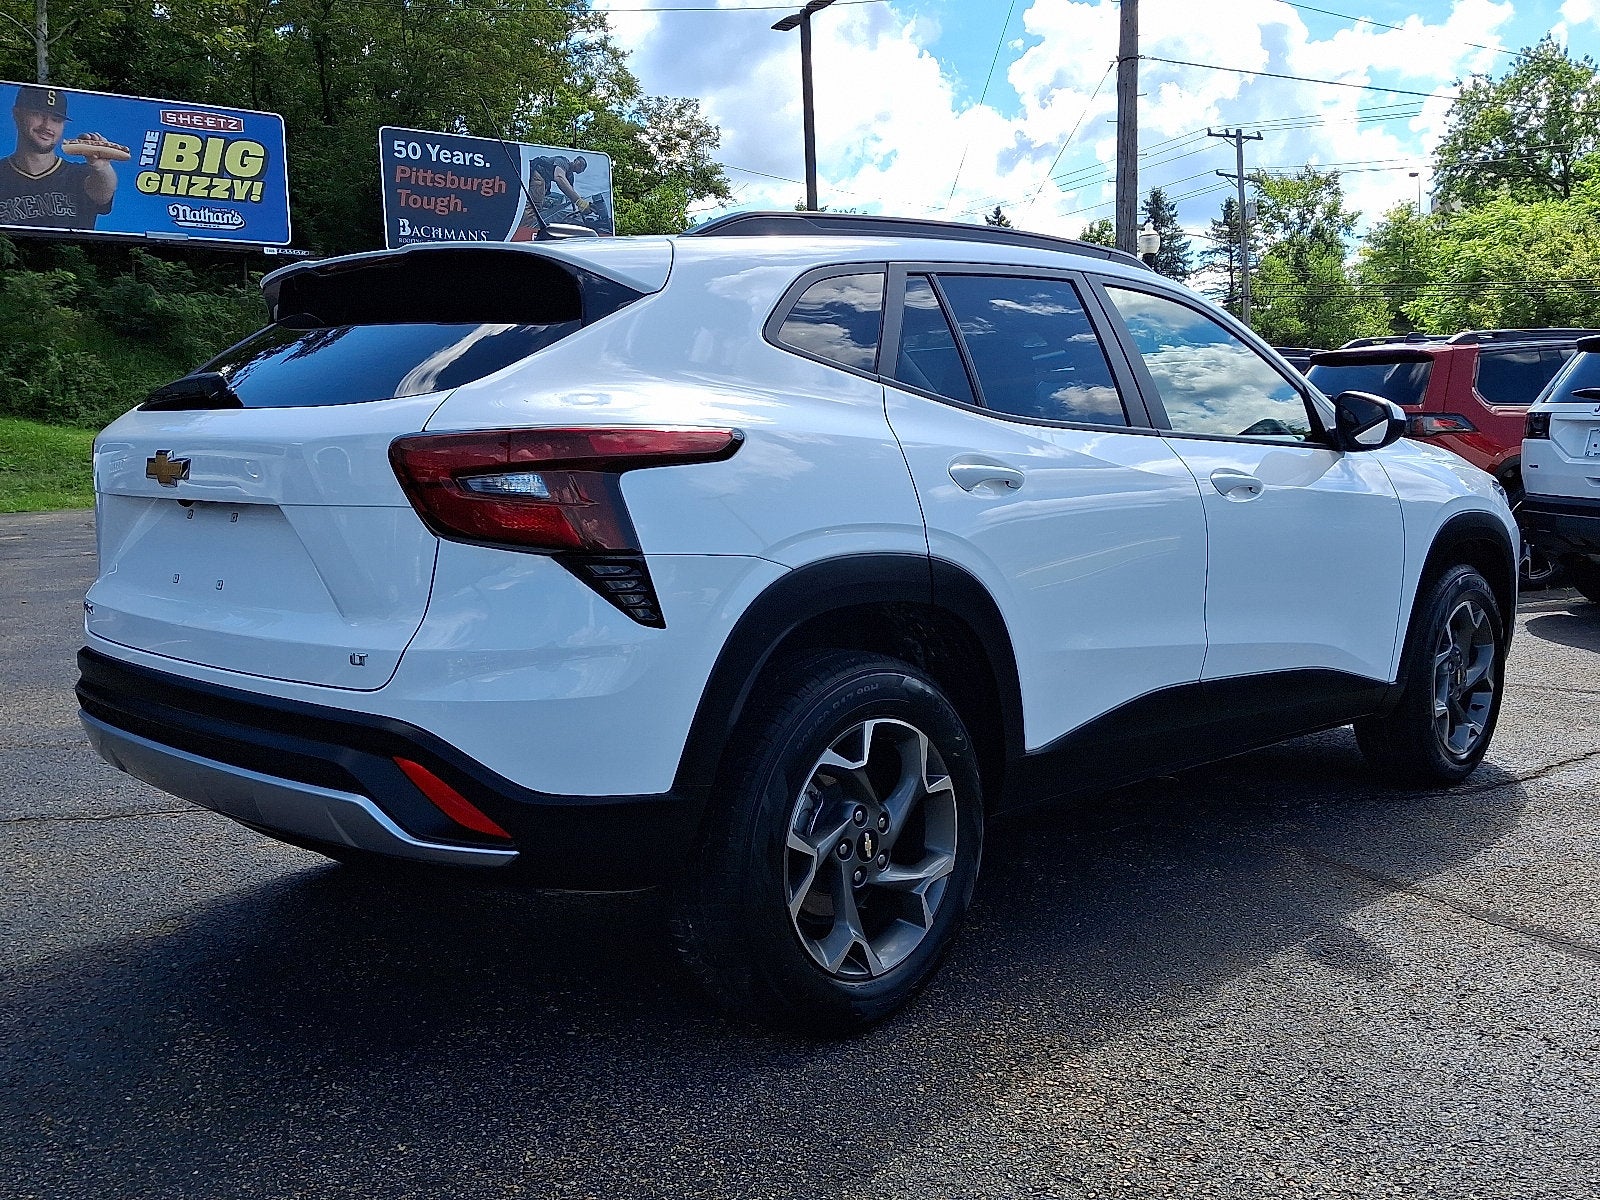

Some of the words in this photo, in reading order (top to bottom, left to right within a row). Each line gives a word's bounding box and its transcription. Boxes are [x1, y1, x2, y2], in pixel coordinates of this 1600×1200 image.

[166, 112, 239, 131] SHEETZ
[140, 131, 160, 166] THE
[159, 132, 265, 178] BIG
[393, 140, 421, 160] 50
[425, 143, 491, 168] Years.
[136, 171, 264, 202] GLIZZY!
[395, 165, 506, 196] Pittsburgh
[168, 203, 243, 225] Nathan's
[397, 188, 468, 215] Tough.
[349, 652, 369, 667] LT
